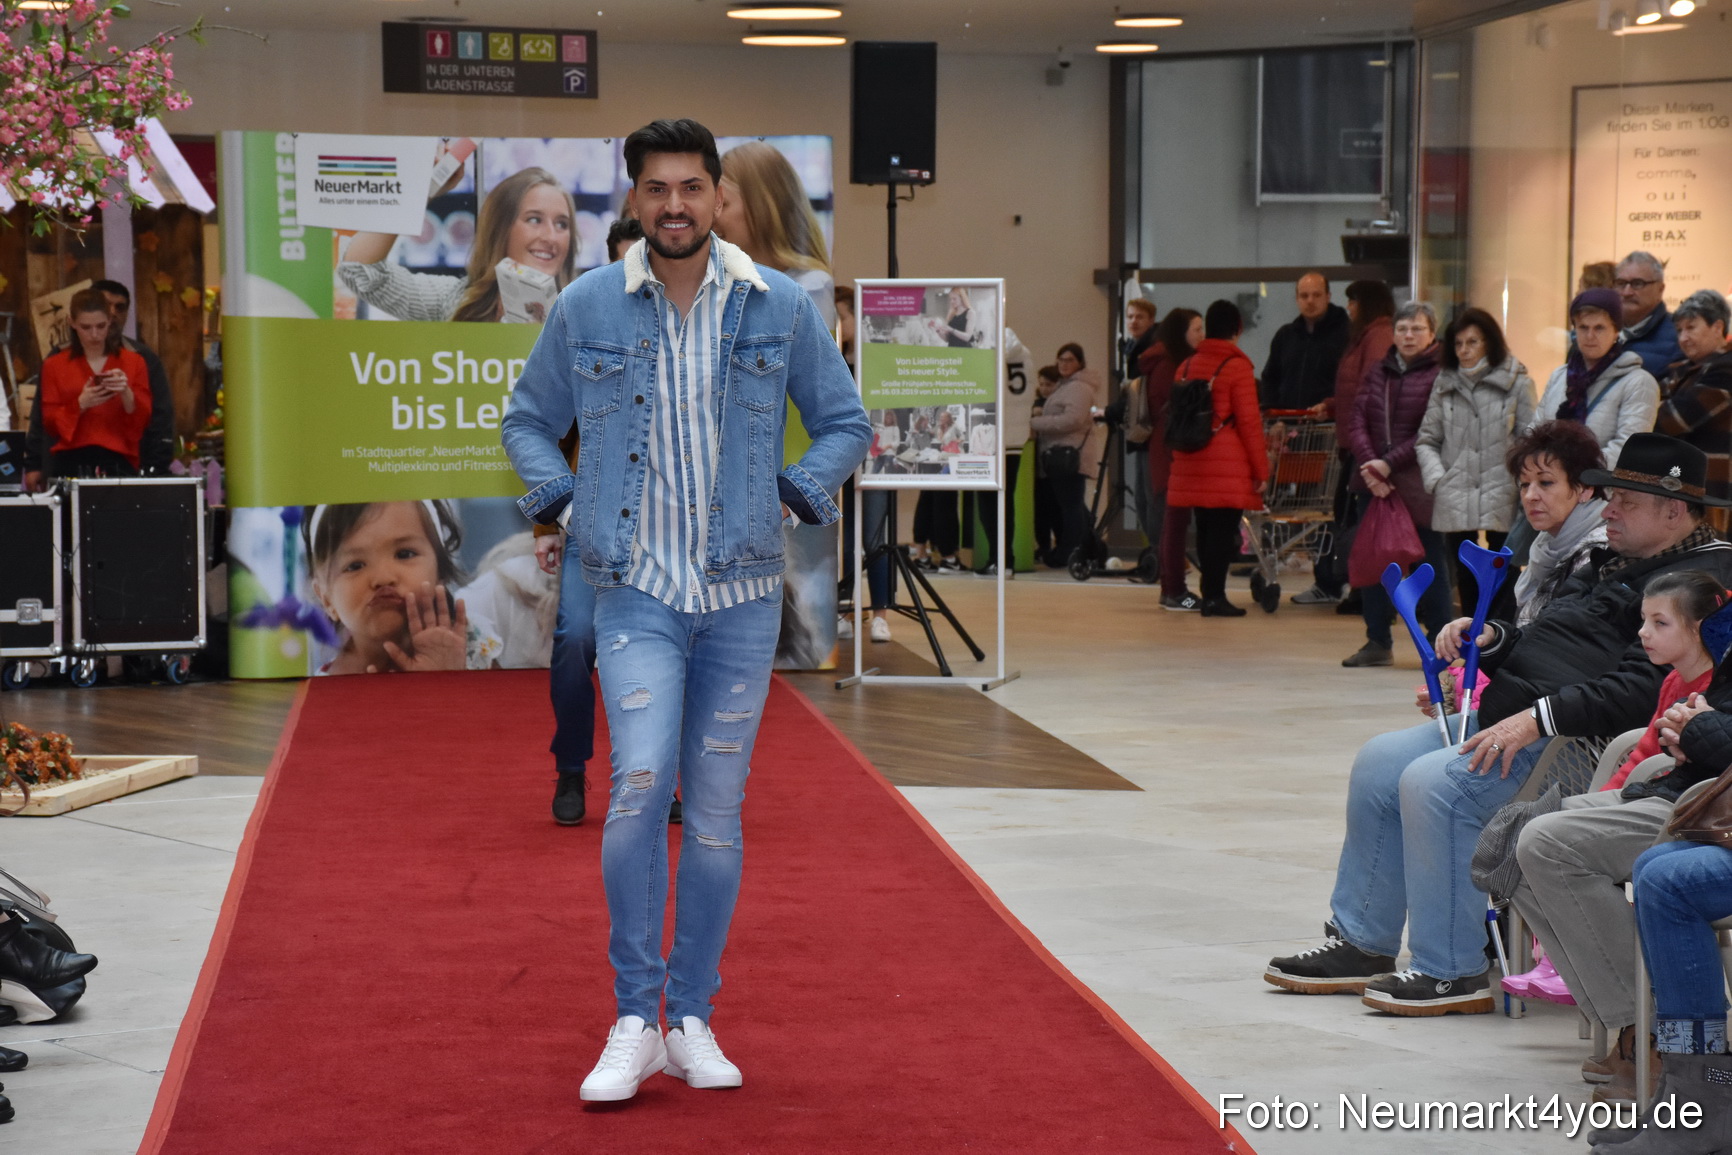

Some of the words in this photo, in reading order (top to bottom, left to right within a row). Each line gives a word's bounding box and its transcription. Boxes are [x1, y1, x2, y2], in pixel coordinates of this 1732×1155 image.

[426, 64, 437, 75] IN
[440, 65, 459, 76] DER
[463, 66, 515, 78] UNTEREN
[426, 79, 515, 92] LADENSTRASSE
[570, 76, 580, 92] P
[1623, 103, 1660, 116] Diese
[1665, 102, 1714, 114] Marken
[1607, 120, 1648, 133] finden
[1651, 118, 1672, 132] Sie
[1677, 120, 1693, 130] im
[314, 179, 402, 194] NeuerMarkt
[319, 197, 335, 205] Alles
[1628, 212, 1663, 222] GERRY
[1665, 210, 1702, 221] WEBER
[1642, 230, 1687, 242] BRAX
[350, 351, 421, 385] Von
[912, 357, 963, 367] Lieblingsteil
[898, 368, 910, 376] bis
[936, 368, 960, 377] Style.
[1007, 362, 1027, 395] 5
[392, 396, 447, 430] bis
[342, 447, 355, 457] Im
[356, 445, 427, 459] Stadtquartier
[368, 461, 440, 474] Multiplexkino
[441, 460, 462, 471] und
